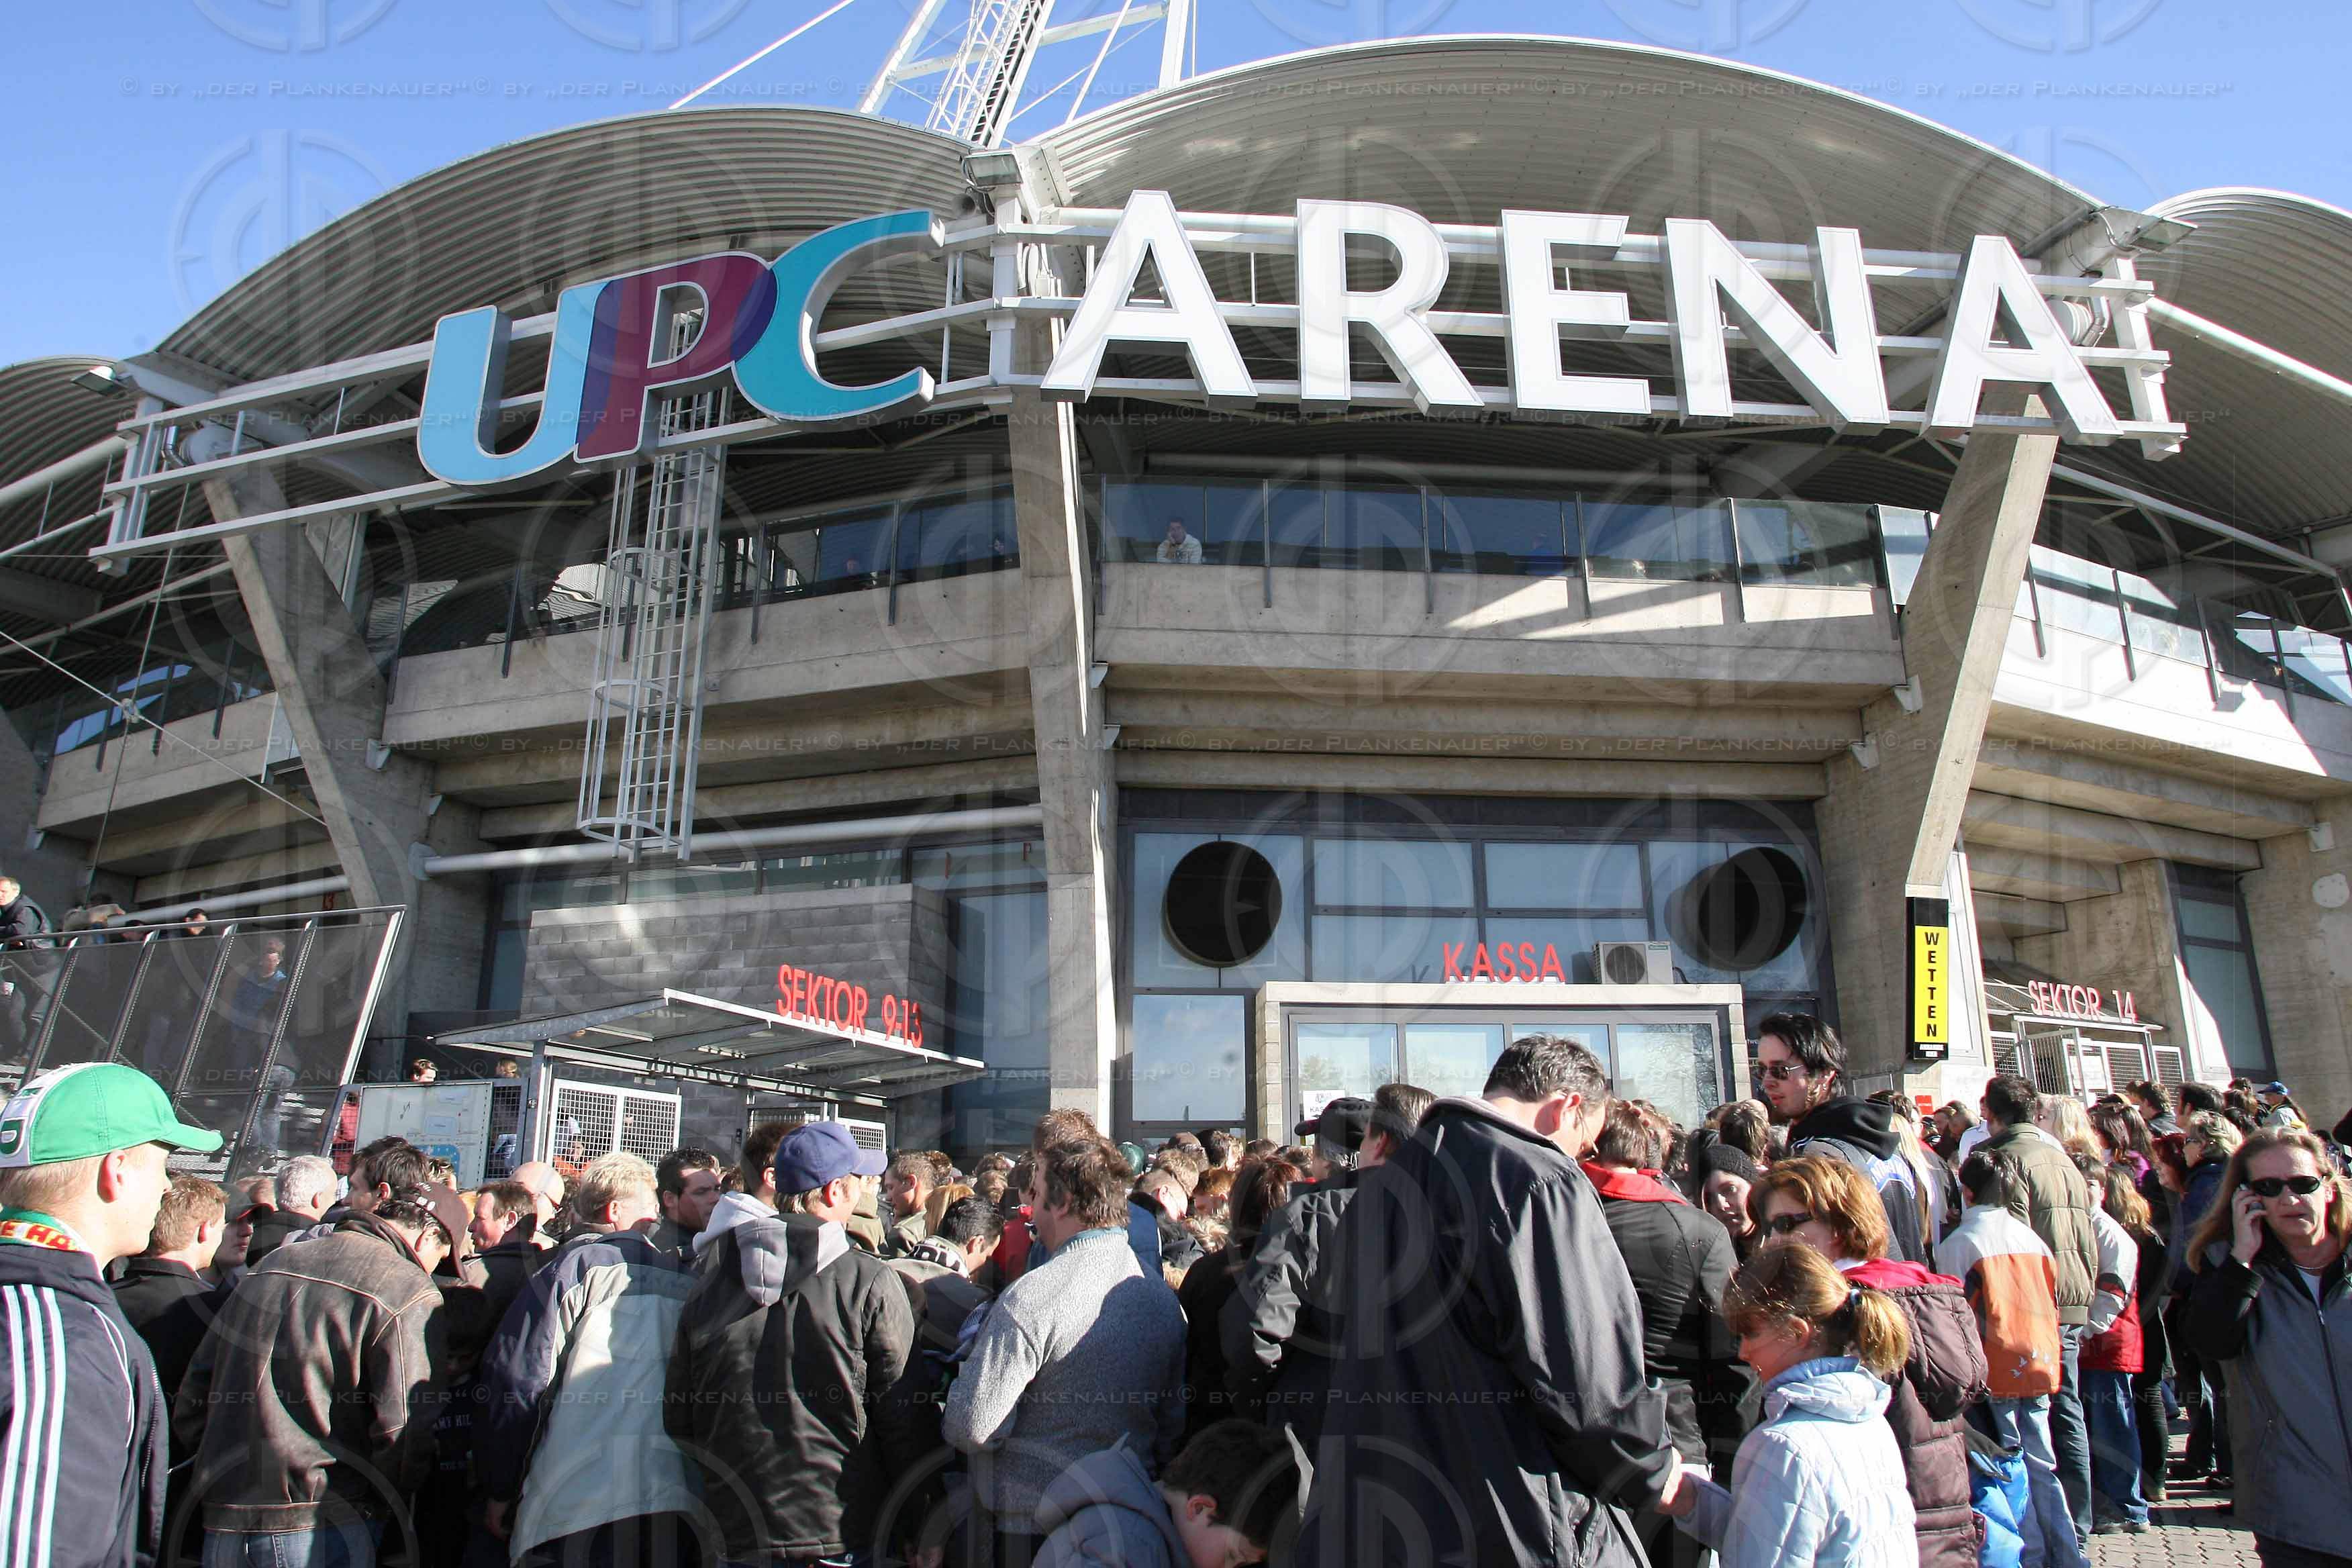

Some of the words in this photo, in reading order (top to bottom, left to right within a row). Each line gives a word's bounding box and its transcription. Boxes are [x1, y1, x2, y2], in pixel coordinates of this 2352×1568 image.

[417, 208, 945, 489] UPC
[1040, 189, 2124, 443] ARENA
[776, 962, 869, 1036] SEKTOR
[881, 994, 924, 1048] 9-13
[1441, 941, 1566, 983] KASSA
[1924, 932, 1940, 1037] WETTEN
[2028, 979, 2102, 1021] SEKTOR
[2112, 988, 2139, 1024] 14
